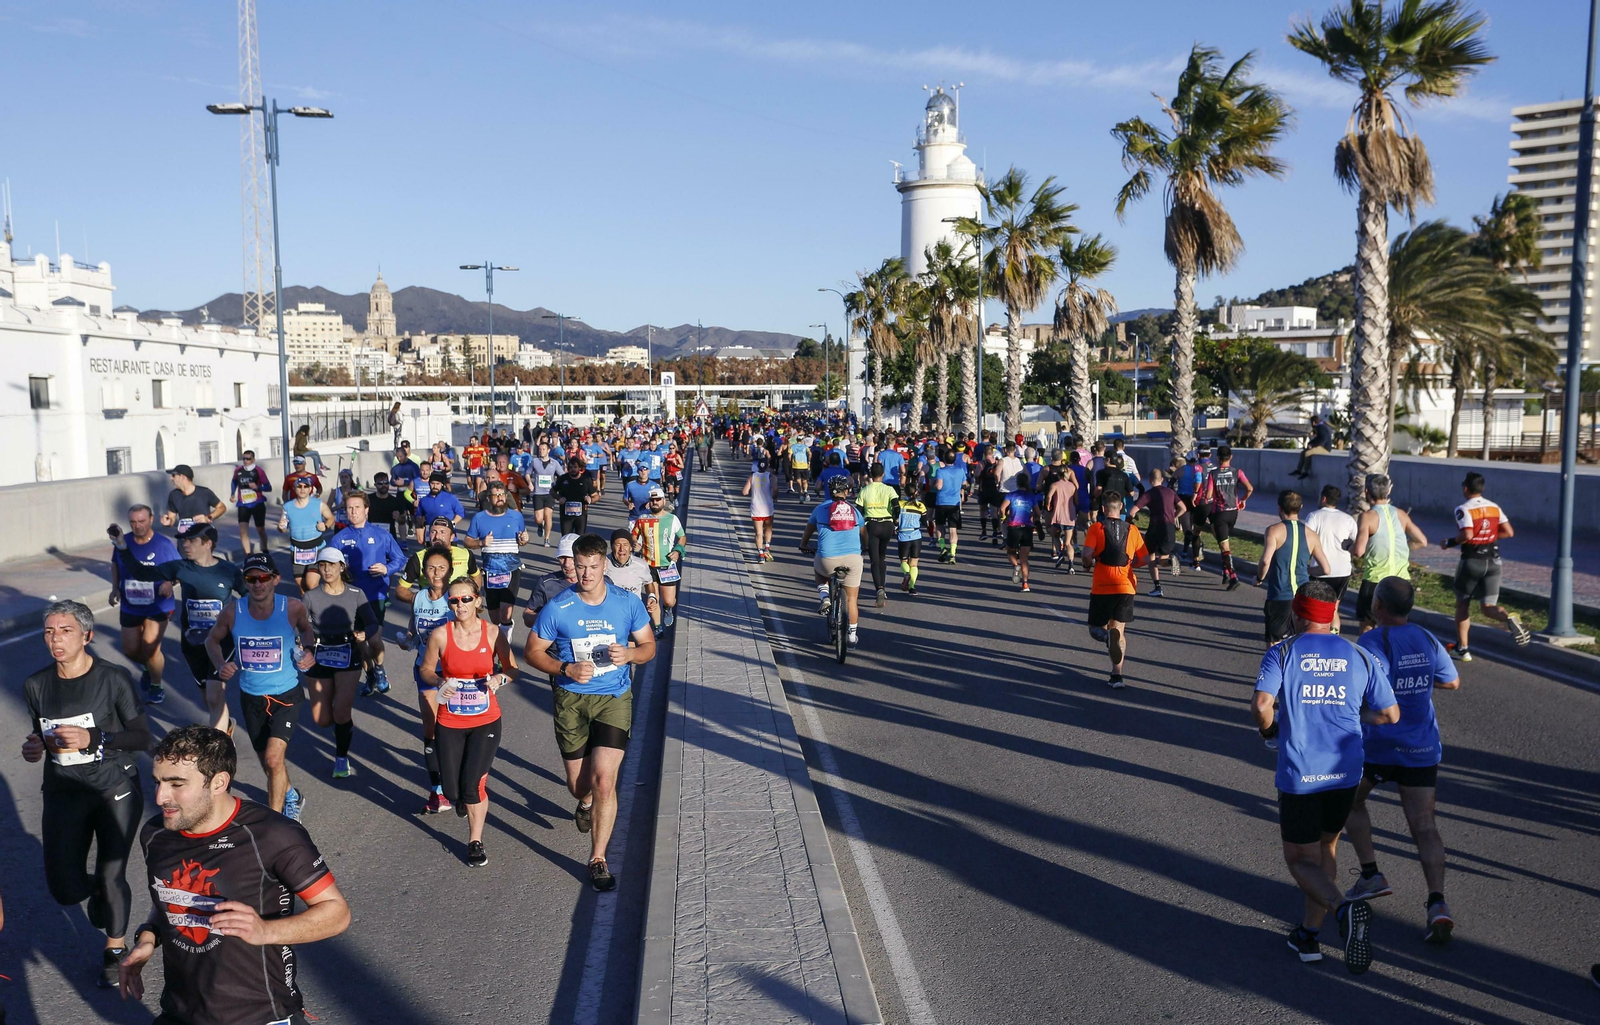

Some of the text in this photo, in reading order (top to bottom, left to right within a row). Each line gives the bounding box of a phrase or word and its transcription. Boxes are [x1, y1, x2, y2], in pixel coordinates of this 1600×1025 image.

[90, 358, 212, 378] RESTAURANTE CASA DE BOTES
[418, 606, 440, 616] nerja
[251, 650, 270, 658] 2672
[1396, 674, 1430, 689] RIBAS
[1302, 685, 1347, 699] RIBAS
